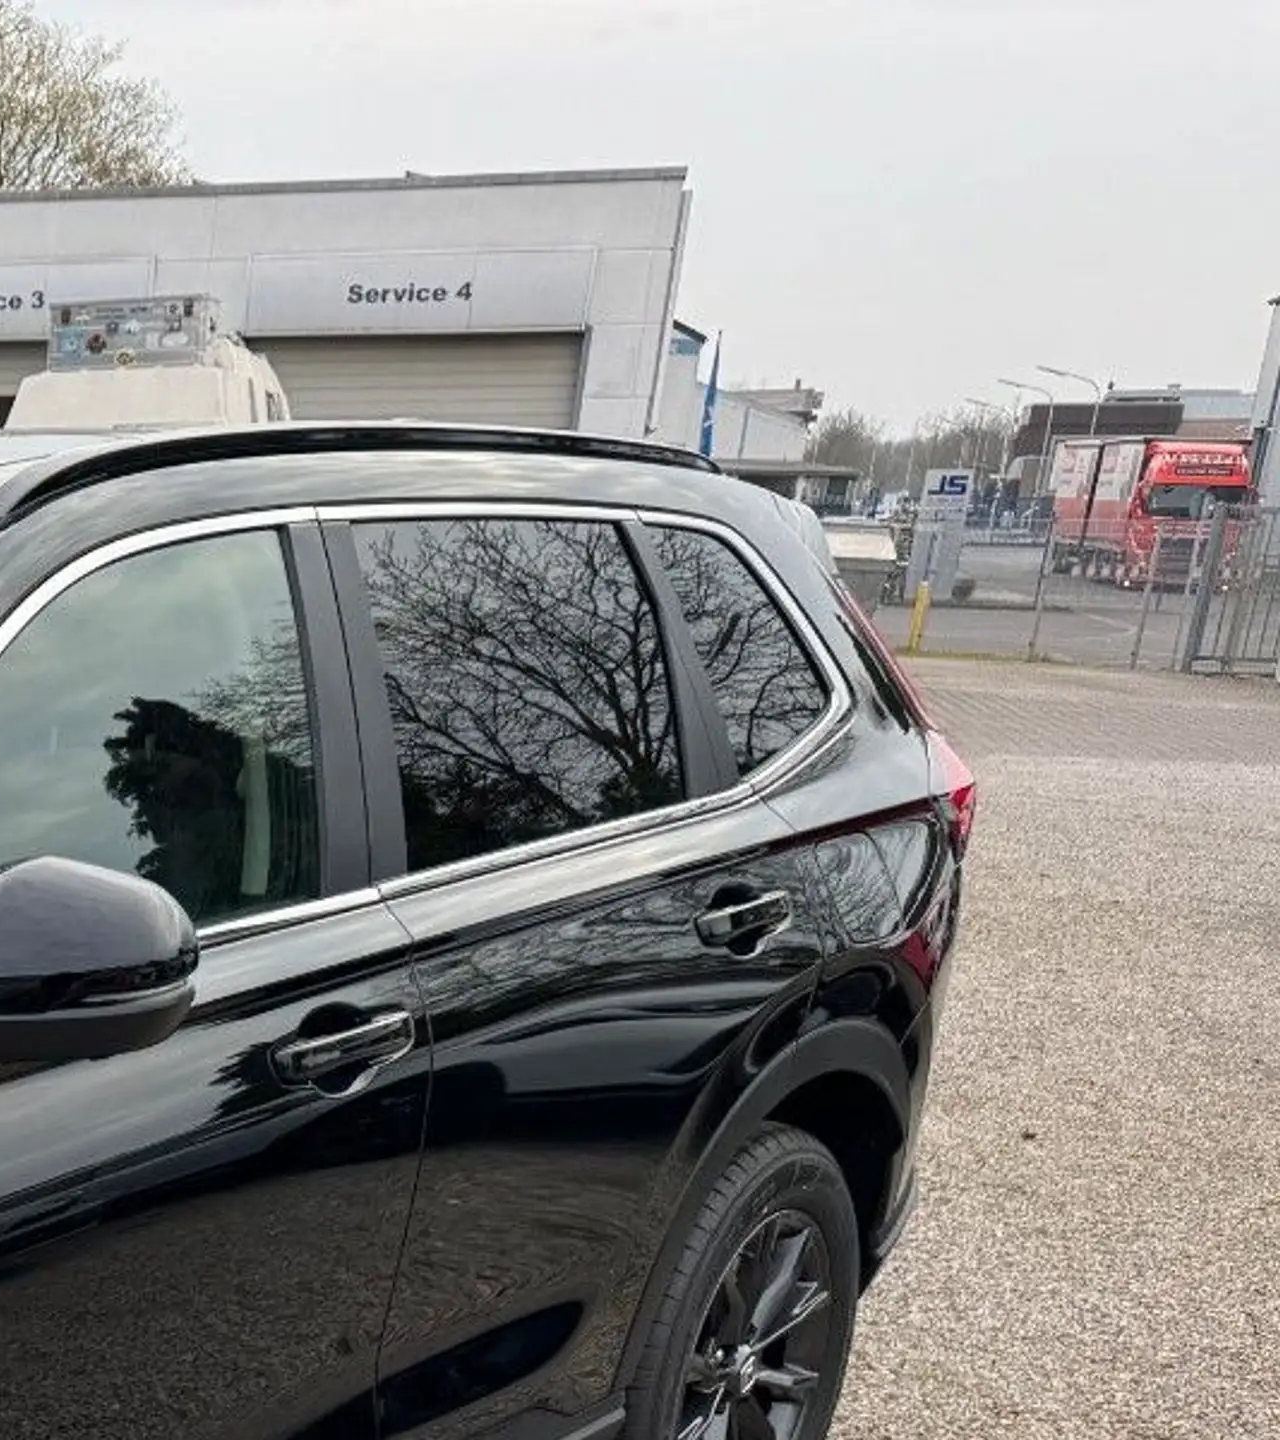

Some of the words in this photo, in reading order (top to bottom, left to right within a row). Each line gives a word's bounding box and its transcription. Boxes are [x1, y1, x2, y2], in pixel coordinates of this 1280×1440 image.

[31, 290, 45, 309] 3
[347, 282, 447, 303] Service
[456, 281, 473, 301] 4
[927, 475, 969, 495] JS
